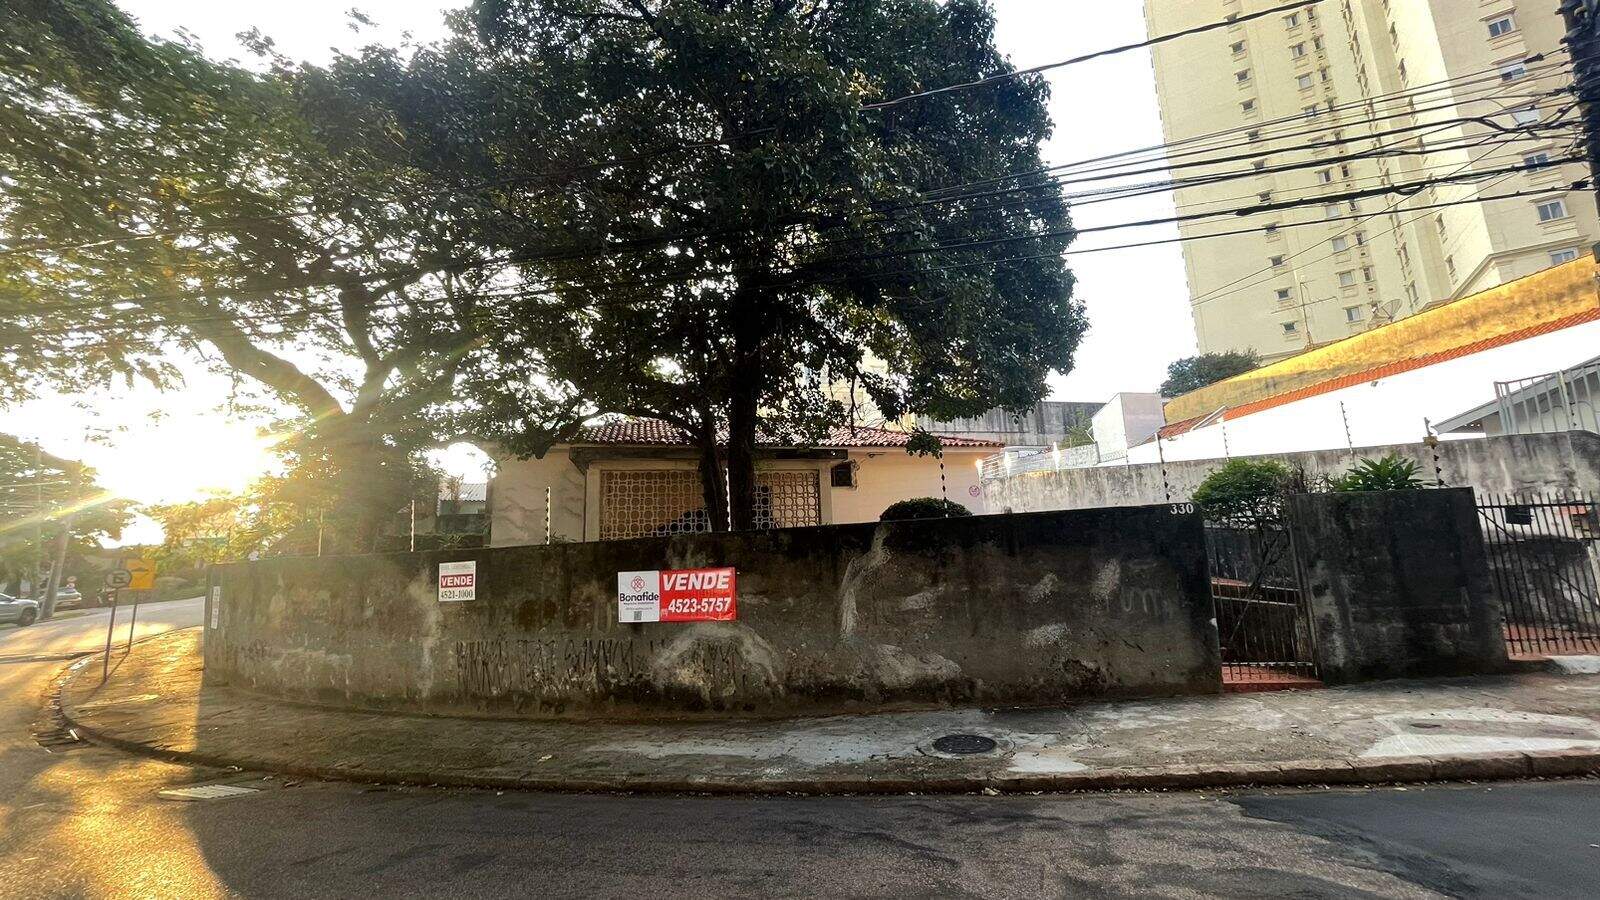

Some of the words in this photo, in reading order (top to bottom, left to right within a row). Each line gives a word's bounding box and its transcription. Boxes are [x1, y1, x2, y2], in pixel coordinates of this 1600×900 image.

[1170, 503, 1194, 514] 330
[441, 576, 473, 587] VENDE
[662, 571, 731, 591] VENDE
[440, 590, 473, 599] 4521-1000
[619, 591, 659, 602] Bonafide
[668, 597, 732, 613] 4523-5757
